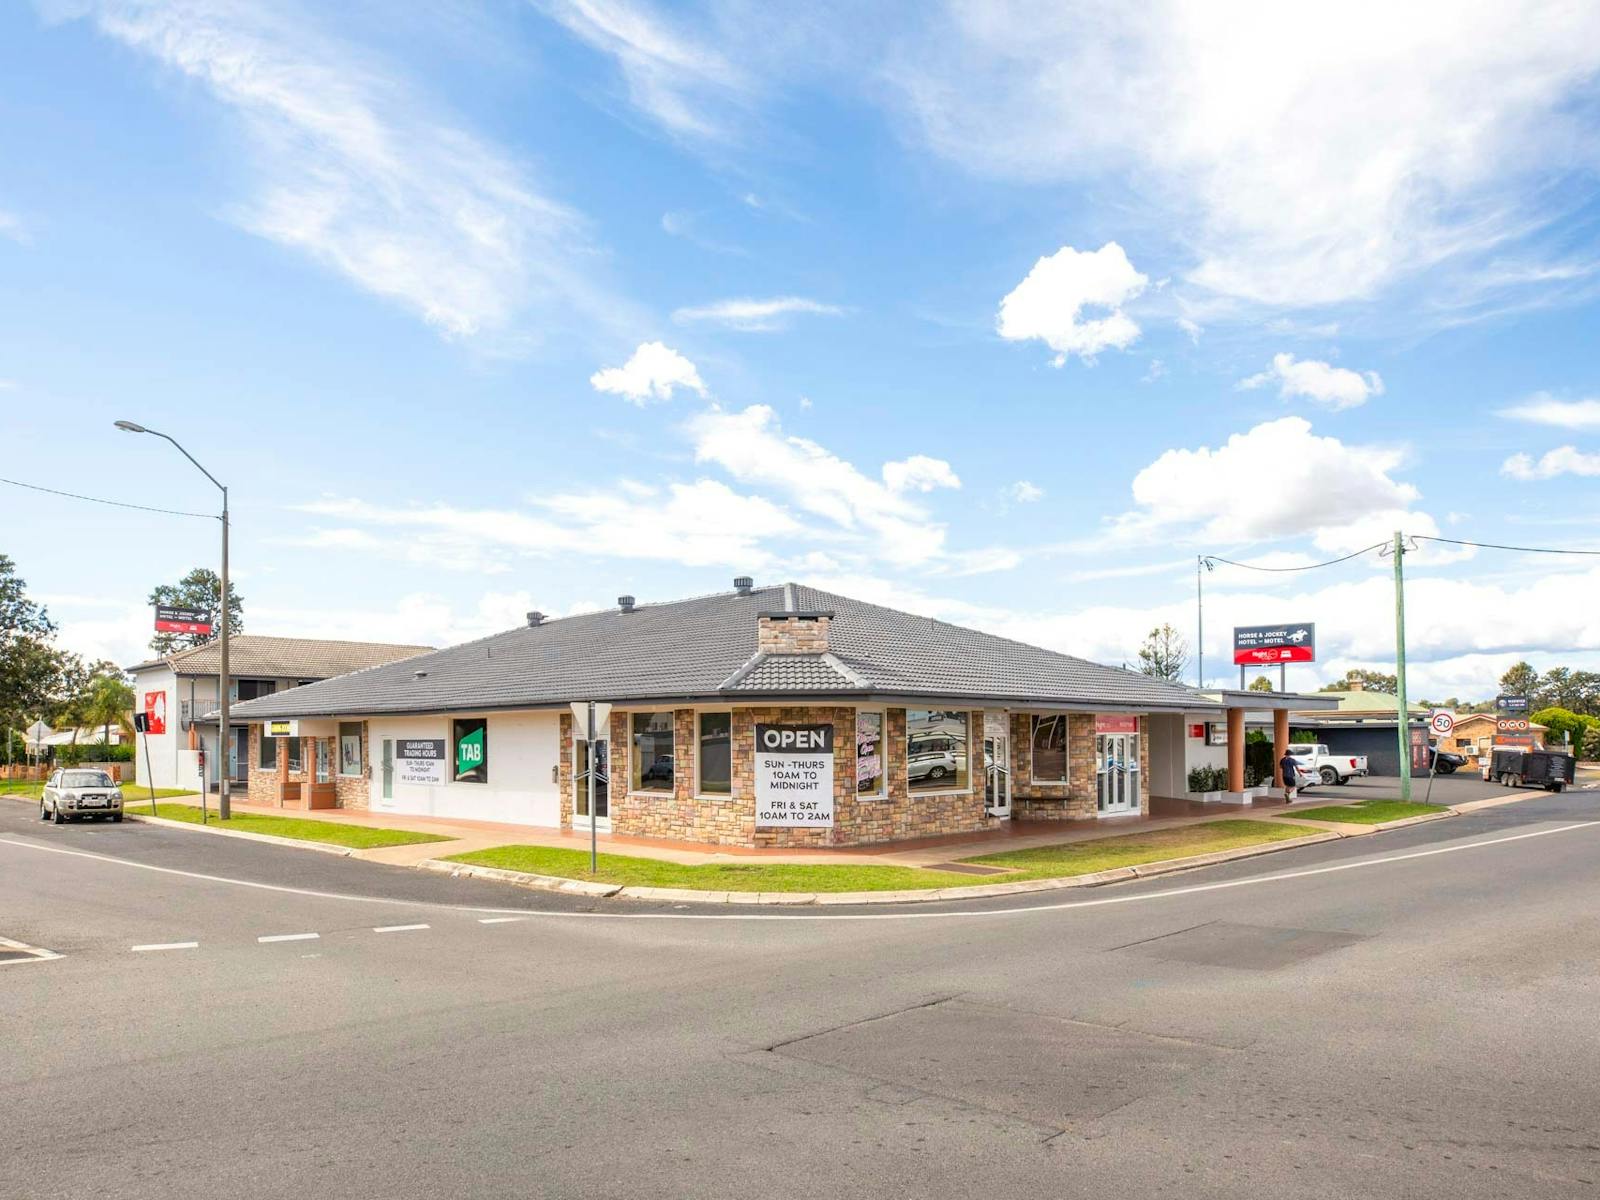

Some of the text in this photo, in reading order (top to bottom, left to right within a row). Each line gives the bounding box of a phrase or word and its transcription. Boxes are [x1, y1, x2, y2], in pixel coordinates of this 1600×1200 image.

[1436, 718, 1450, 728] 50
[764, 729, 825, 748] OPEN
[460, 744, 481, 761] TAB
